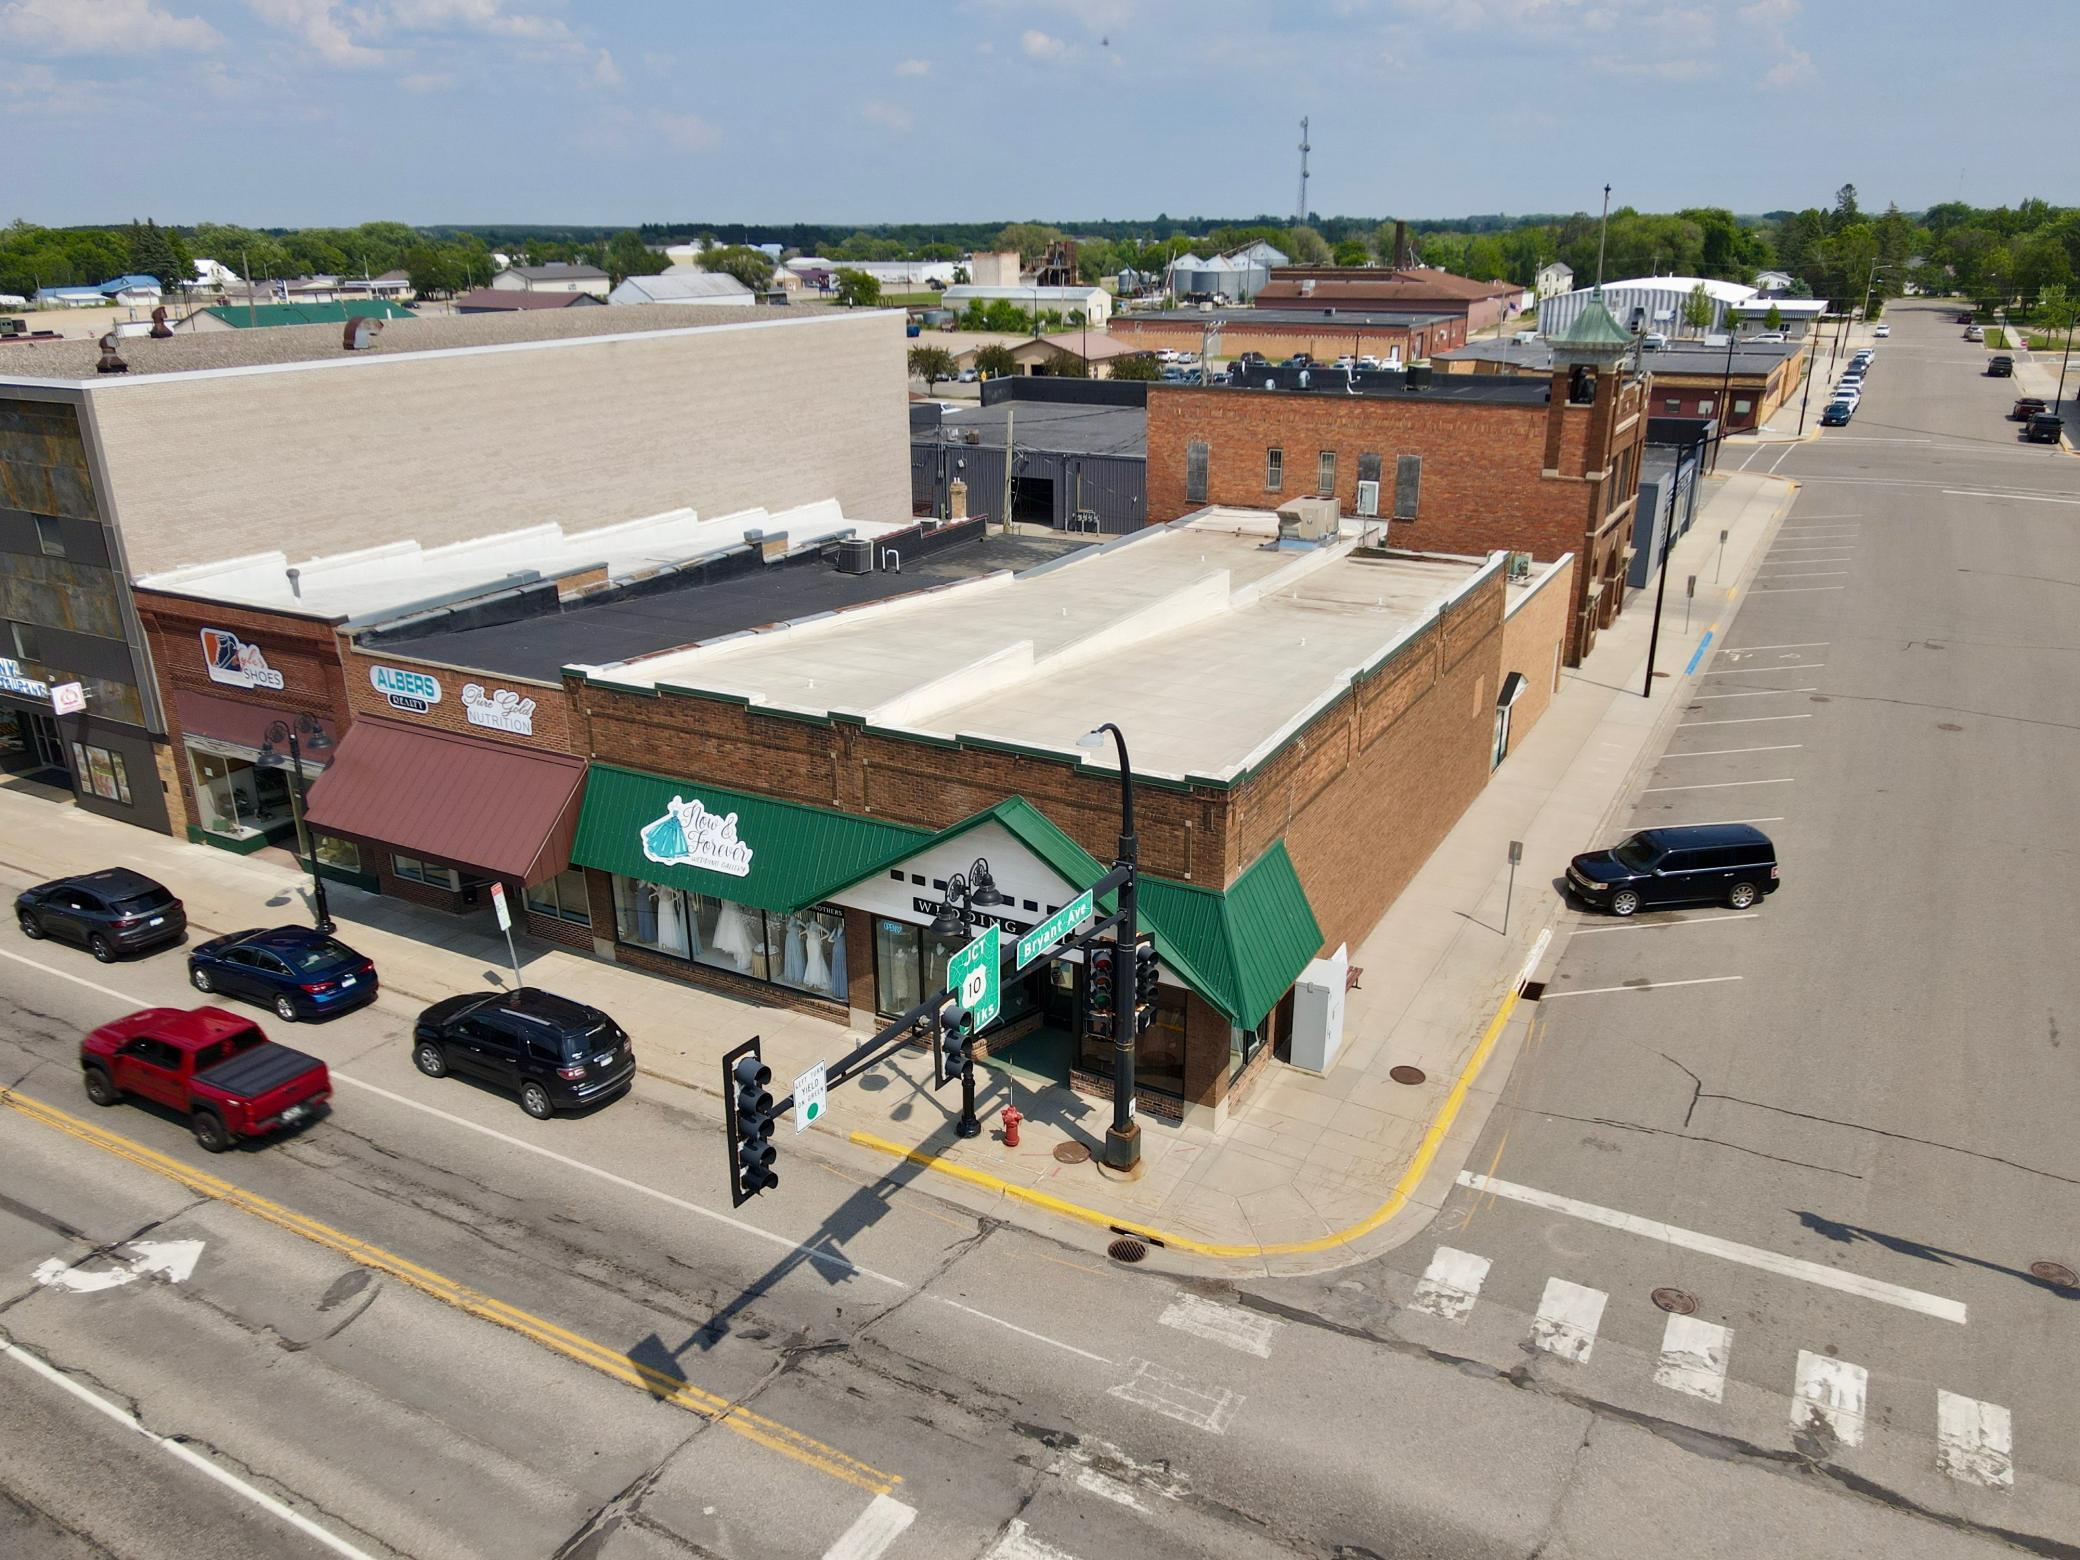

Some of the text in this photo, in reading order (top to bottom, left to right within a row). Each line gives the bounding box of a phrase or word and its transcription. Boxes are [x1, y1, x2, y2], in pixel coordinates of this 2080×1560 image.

[244, 667, 281, 685] SHOES
[377, 668, 434, 698] ALBERS
[392, 695, 424, 710] REALTY
[464, 686, 534, 717] Pure Gold
[469, 710, 530, 733] NUTRITION
[682, 803, 735, 840] Now &
[687, 829, 750, 863] Forever
[1024, 919, 1063, 958] Bryant
[1067, 903, 1087, 926] Ave
[963, 938, 986, 967] JCT
[968, 976, 981, 999] 10
[801, 1078, 819, 1096] YIELD
